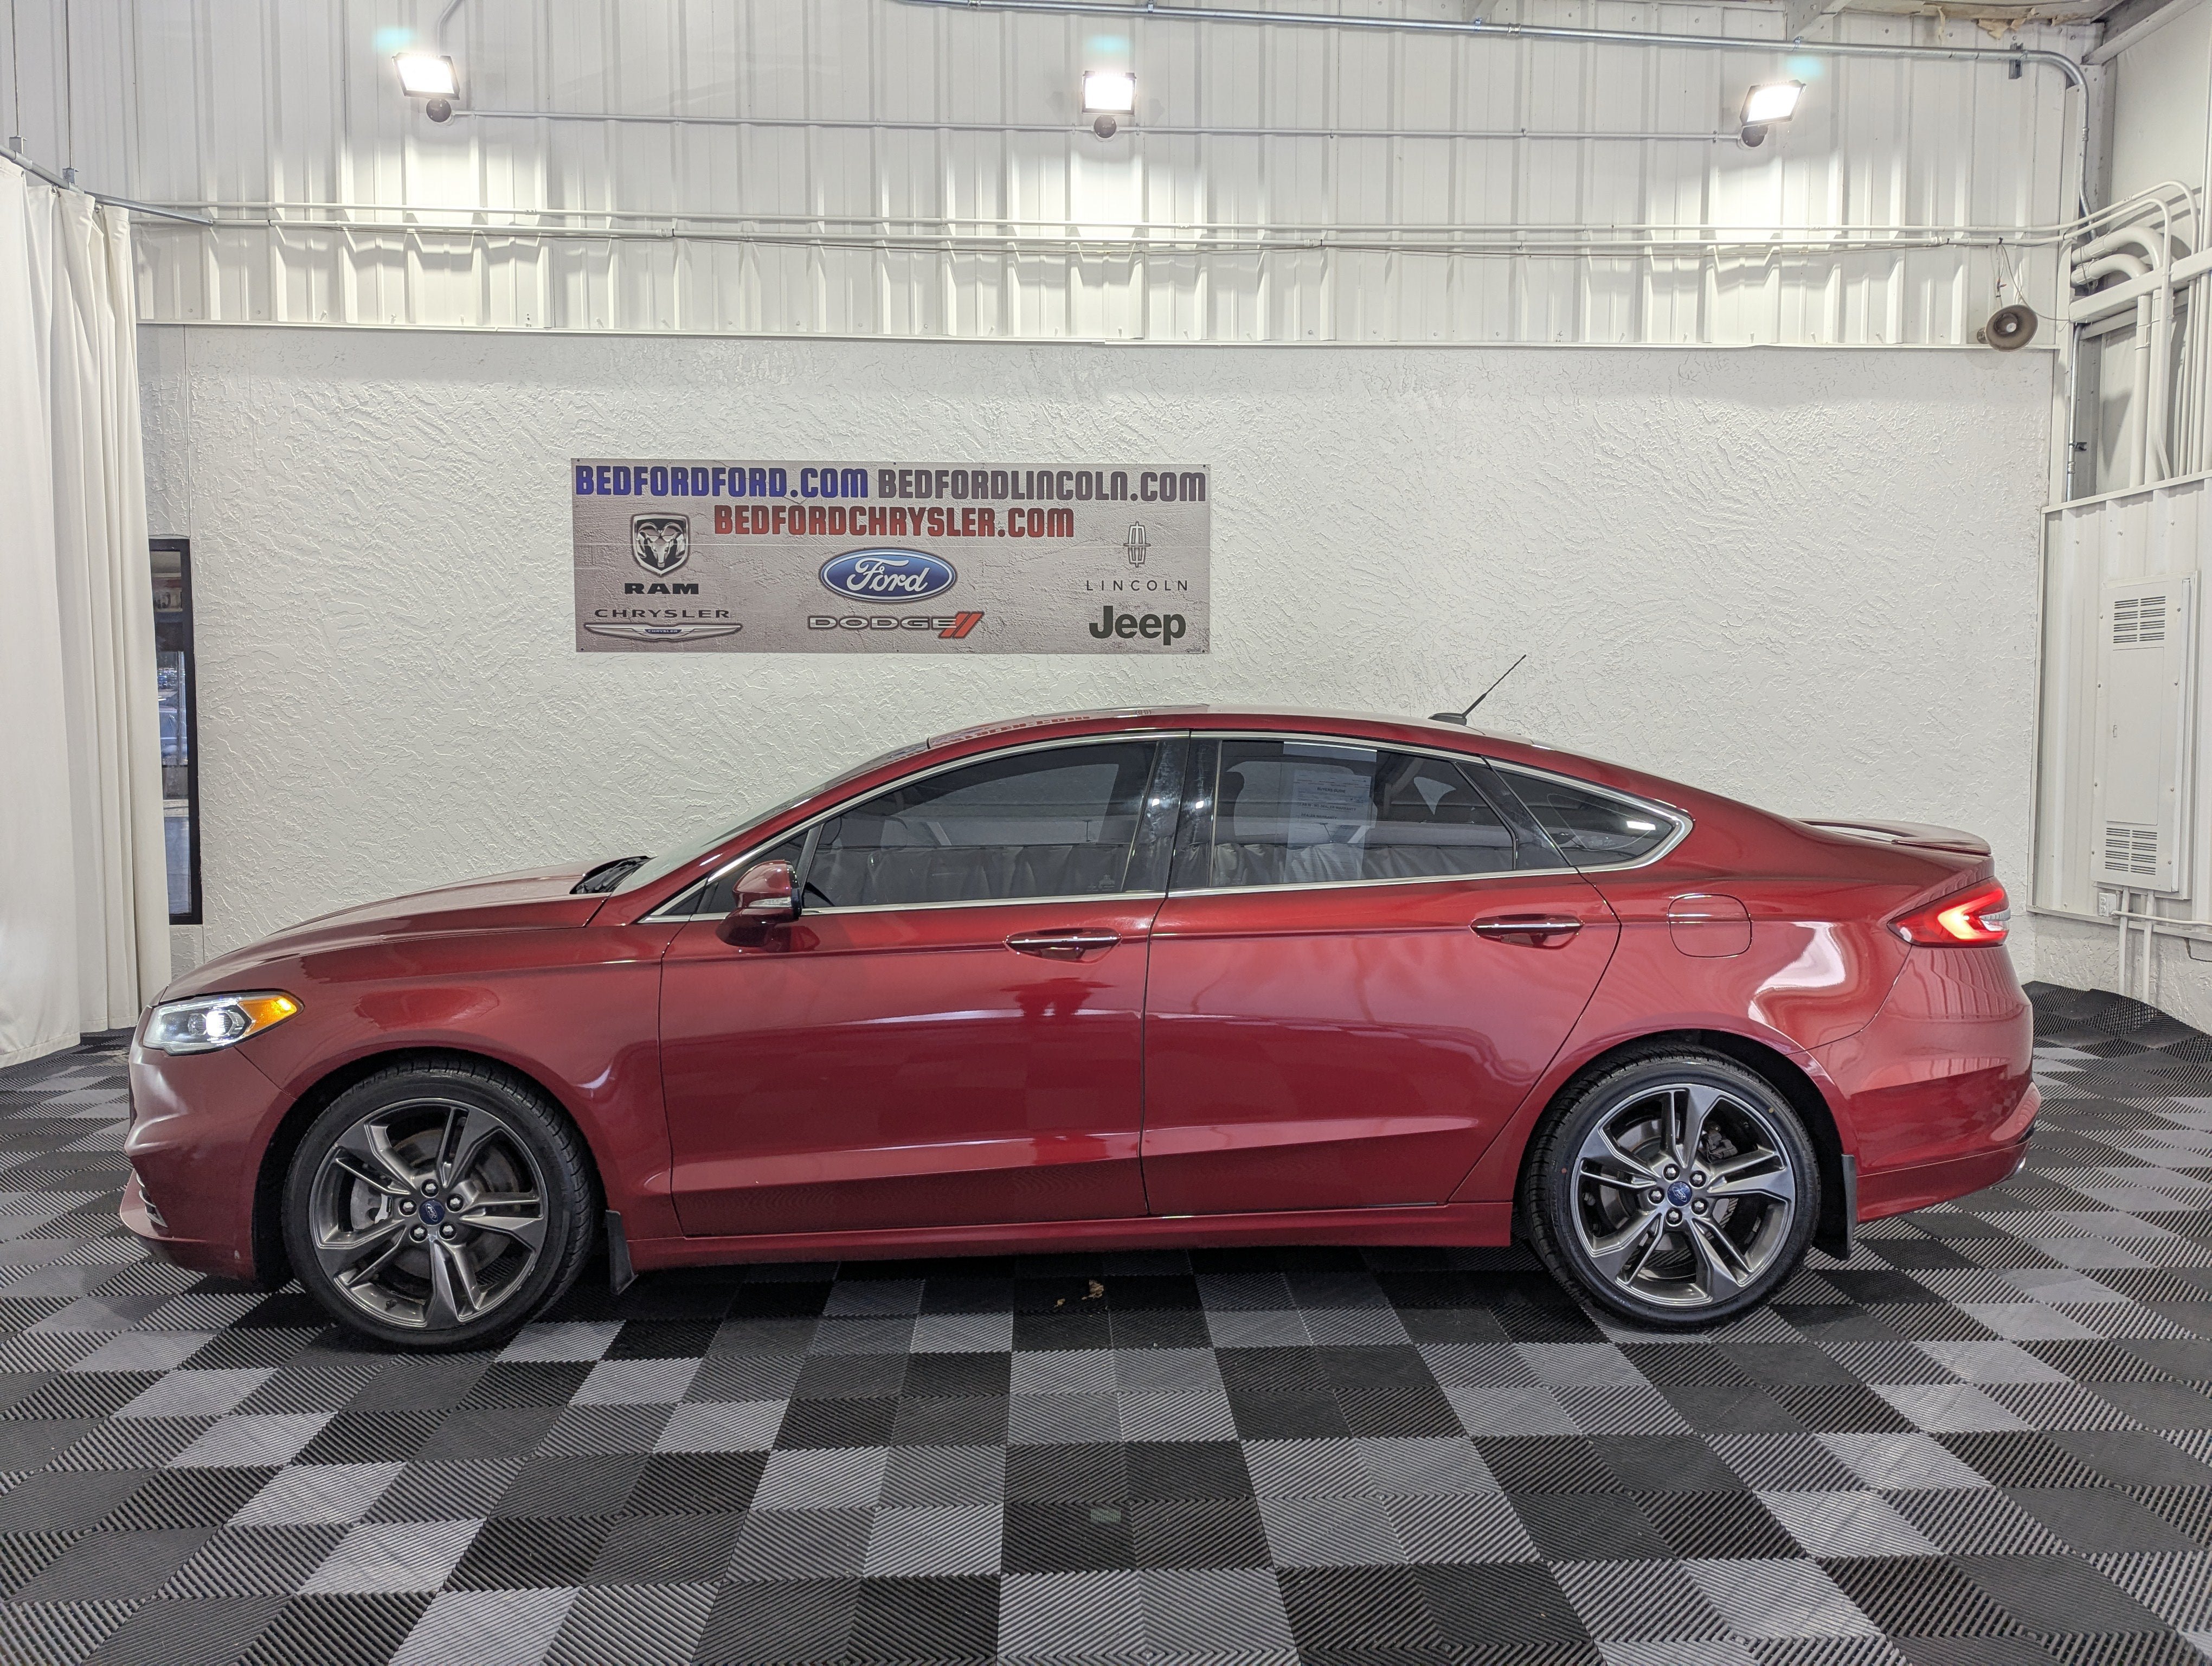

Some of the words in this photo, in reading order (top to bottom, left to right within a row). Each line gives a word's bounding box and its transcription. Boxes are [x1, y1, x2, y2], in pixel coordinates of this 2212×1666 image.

[576, 465, 868, 498] BEDFORDFORD.COM
[878, 469, 1206, 502] BEDFORDLINCOLN.COM
[714, 505, 1074, 537] BEDFORDCHRYSLER.COM
[846, 558, 930, 592] Ford
[1086, 580, 1187, 591] LINCOLN
[625, 583, 699, 594] RAM
[595, 609, 730, 618] CHRYSLER
[809, 616, 957, 630] DODGE
[1089, 605, 1186, 646] Jeep
